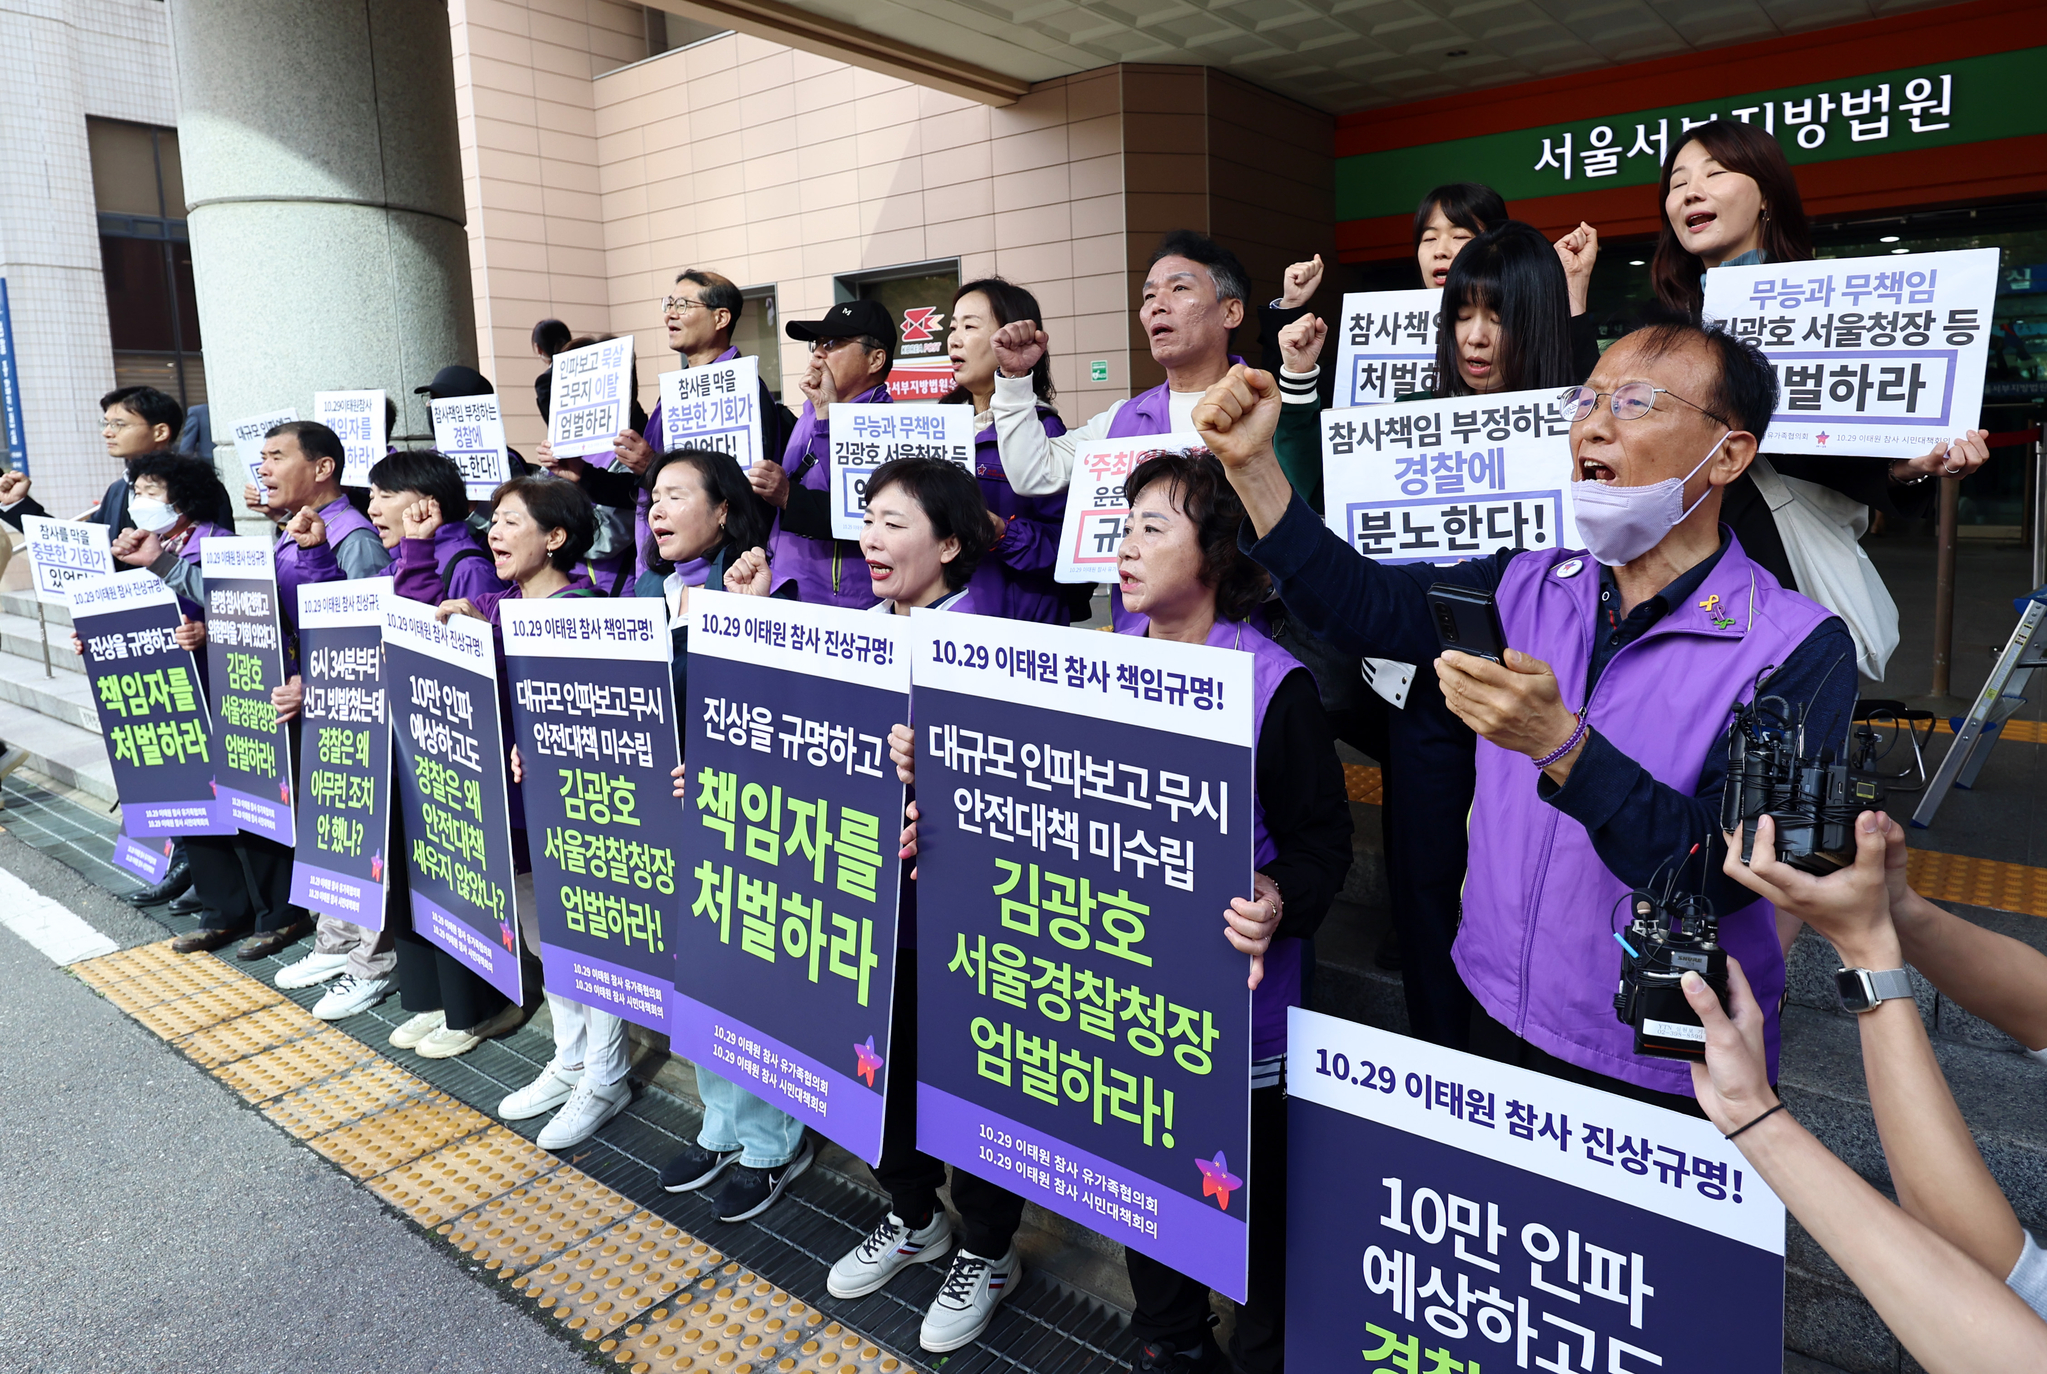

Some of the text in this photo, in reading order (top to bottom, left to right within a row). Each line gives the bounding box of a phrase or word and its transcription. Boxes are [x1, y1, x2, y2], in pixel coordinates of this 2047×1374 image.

[1749, 269, 1937, 310] 무능과 무책임
[901, 342, 942, 355] KOREA POST
[1802, 310, 1936, 348] 서울청장
[1942, 309, 1980, 345] 등
[560, 344, 624, 380] 인파보고 묵살
[679, 369, 736, 400] 참사를 막을
[560, 372, 619, 407] 근무지 이탈
[1771, 363, 1926, 414] 벌하라
[236, 425, 261, 441] 대규모
[434, 403, 497, 424] 참사책임 부정하는
[561, 406, 611, 440] 엄벌하라
[668, 393, 753, 433] 충분한 기회가
[853, 415, 945, 440] 무능과 무책임
[1329, 403, 1570, 455] 참사책임 부정하는
[1767, 431, 1808, 440] 유가족협의회
[453, 425, 483, 448] 경찰에
[836, 442, 881, 466] 김광호
[1837, 434, 1856, 442] 10.29
[1859, 435, 1882, 443] 이태원
[1883, 436, 1899, 444] 참사
[454, 455, 497, 479] 노한다!
[1394, 447, 1505, 496] 경찰에
[39, 523, 90, 546] 참사를 막을
[1358, 502, 1546, 554] 분노한다!
[32, 541, 106, 570] 충분한 기회가
[73, 591, 95, 605] 10.29
[97, 588, 117, 601] 이태원
[117, 585, 132, 598] 참사
[133, 577, 165, 597] 진상규명!
[210, 590, 226, 614] 분명
[226, 590, 241, 616] 참사
[304, 600, 322, 614] 10.29
[322, 596, 341, 614] 이태원
[342, 595, 355, 613] 참사
[87, 626, 179, 662] 진상을 규명하고
[237, 621, 253, 648] 기회
[252, 623, 277, 651] 있었다!
[387, 612, 484, 658] 10.29 이태원 참사 진상규명!
[513, 618, 654, 642] 10.29 이태원 참사 책임규명!
[701, 613, 894, 665] 10.29 이태원 참사 진상규명!
[226, 651, 265, 692] 김광호
[310, 646, 380, 682] 6시 34분부터
[932, 639, 1224, 710] 10.29 이태원 참사 책임규명!
[96, 666, 197, 718] 책임자를
[220, 694, 278, 735] 서울경찰청장
[303, 685, 385, 725] 신고 빗발쳤는데
[409, 675, 474, 731] 10만 인파
[515, 679, 664, 724] 대규모 인파보고 무시
[110, 718, 210, 768] 처벌하라
[225, 733, 277, 779] 엄벌하라!
[318, 726, 370, 769] 경찰은 왜
[409, 712, 483, 773] 예상하고도
[533, 722, 653, 768] 안전대책 미수립
[703, 696, 883, 779] 진상을 규명하고
[310, 769, 374, 816] 아무런 조치
[414, 754, 483, 823] 경찰은 왜
[558, 768, 641, 827] 김광호
[929, 724, 1229, 835] 대규모 인파보고 무시
[317, 813, 364, 858] 안 했나?
[422, 803, 487, 872] 안전대책
[695, 766, 883, 903] 책임자를
[953, 787, 1194, 892] 안전대책 미수립
[412, 839, 506, 921] 세우지 않았나?
[544, 826, 676, 895] 서울경찰청장
[560, 885, 665, 954] 엄벌하라!
[691, 860, 879, 1008] 처벌하라
[992, 857, 1153, 967] 김광호
[1678, 955, 1703, 963] SHURE
[947, 932, 1220, 1075] 서울경찰청장
[712, 1043, 828, 1118] 10.29 이태원 참사 시민대책회의
[714, 1025, 829, 1097] 10.29 이태원 참사 유가족협의회
[970, 1015, 1176, 1149] 엄벌하라!
[1315, 1048, 1744, 1204] 10.29 이태원 참사 진상규명!
[978, 1123, 1158, 1217] 10.29 이태원 참사 유가족협의회
[978, 1144, 1158, 1240] 10.29 이태원 참사 시민대책회의
[1380, 1176, 1655, 1330] 10만 인파
